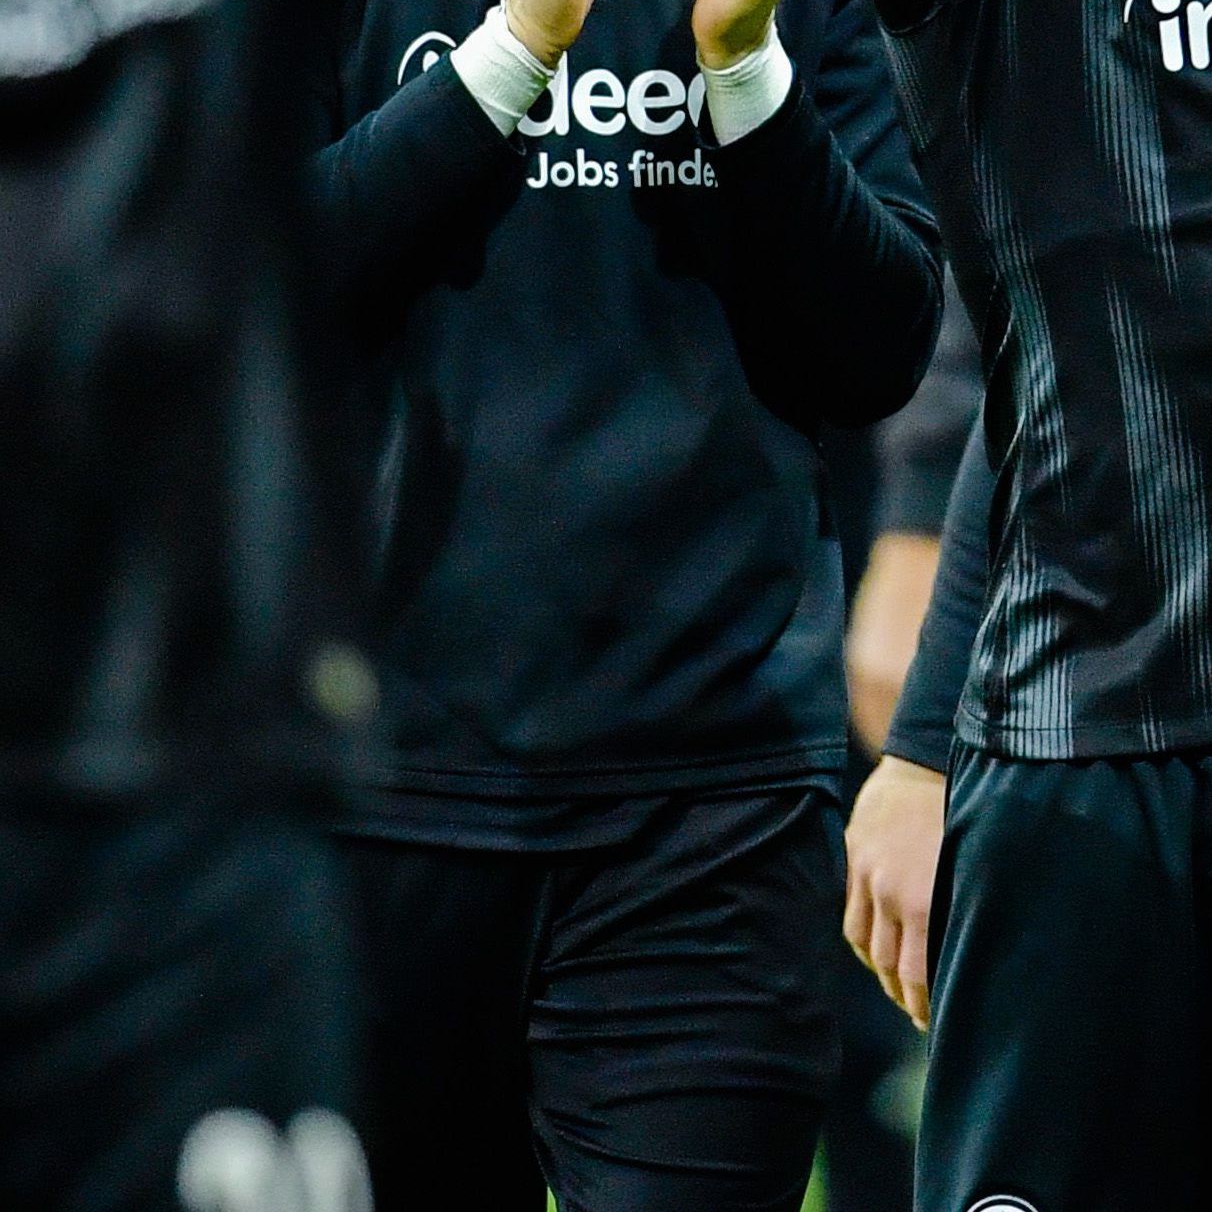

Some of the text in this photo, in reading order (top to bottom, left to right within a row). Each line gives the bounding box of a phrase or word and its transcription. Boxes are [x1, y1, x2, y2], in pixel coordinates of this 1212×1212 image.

[422, 50, 706, 136] dee
[526, 148, 719, 188] Jobs finde
